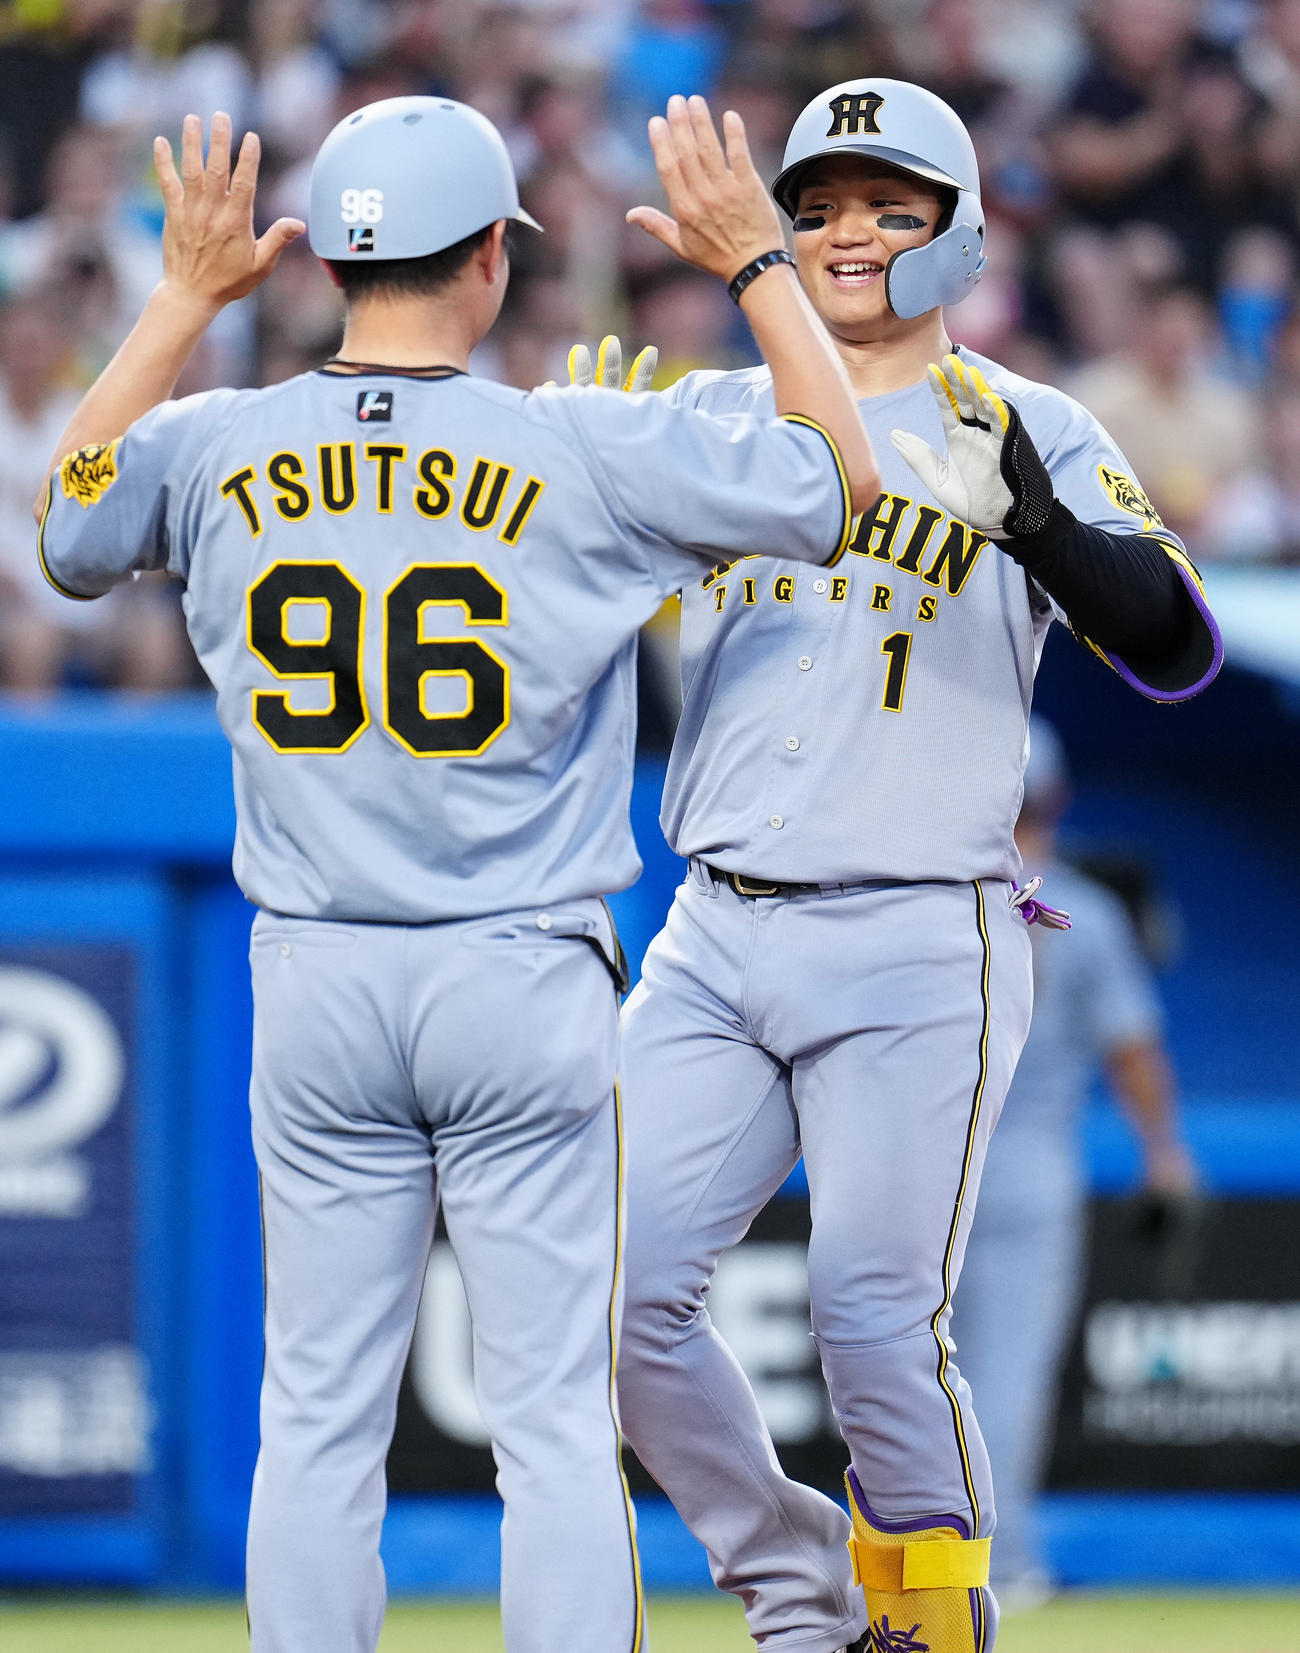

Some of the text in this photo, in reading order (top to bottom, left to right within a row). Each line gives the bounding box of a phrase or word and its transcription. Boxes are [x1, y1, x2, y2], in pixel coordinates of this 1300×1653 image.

[340, 187, 384, 224] 96
[219, 441, 546, 547] TSUTSUI
[715, 575, 938, 623] TIGERS
[246, 558, 511, 759] 96
[880, 630, 913, 713] 1
